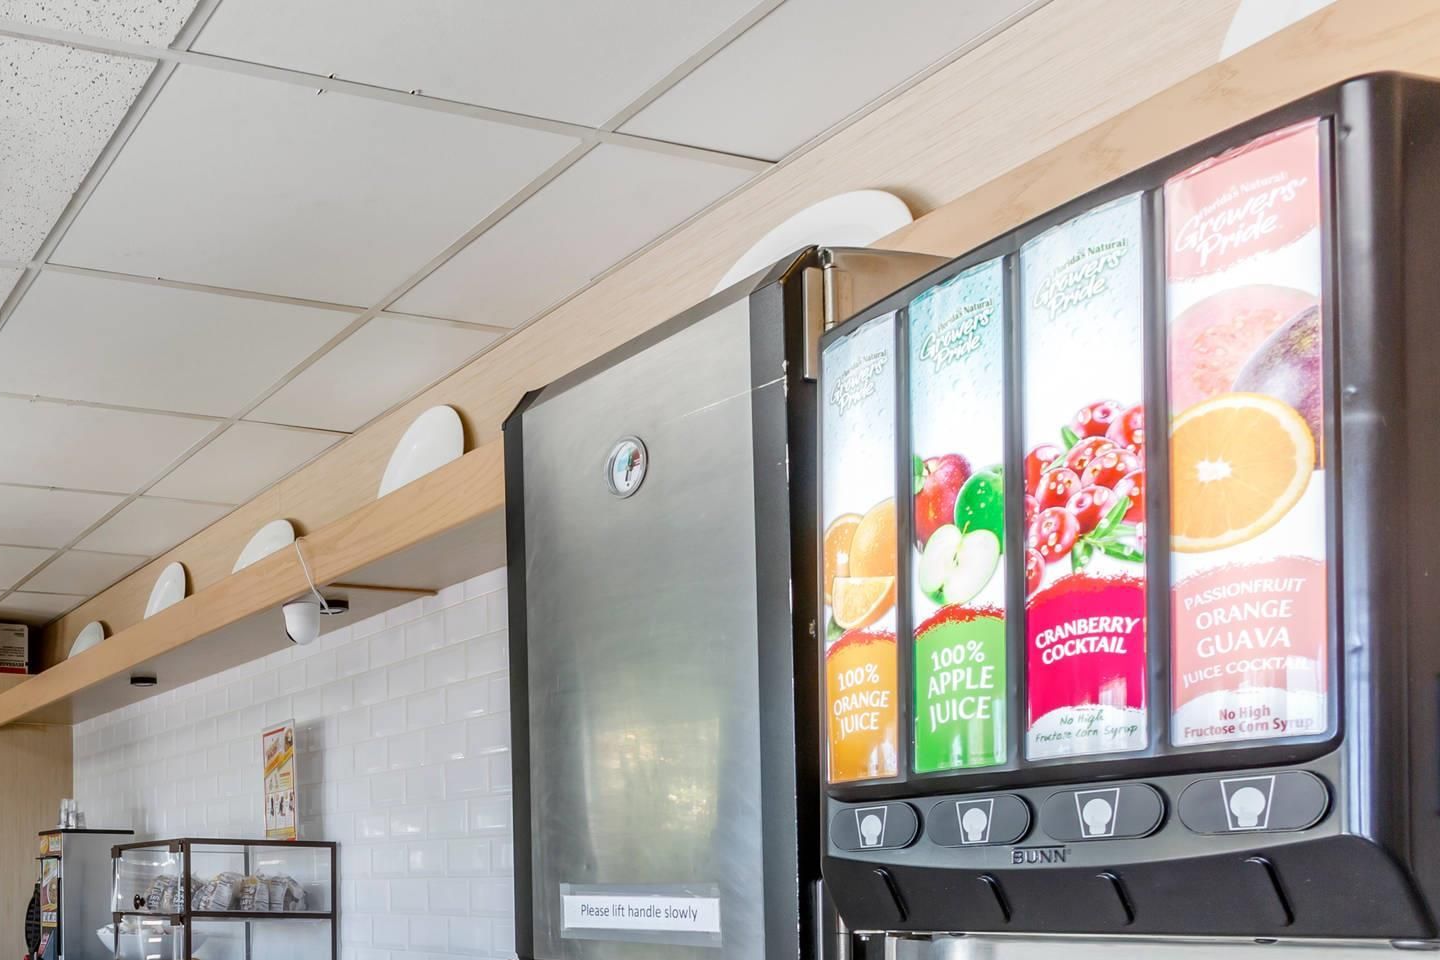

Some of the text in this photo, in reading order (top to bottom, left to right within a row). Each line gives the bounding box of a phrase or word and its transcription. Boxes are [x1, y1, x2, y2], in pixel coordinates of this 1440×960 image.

[1087, 238, 1126, 256] Natural
[1195, 211, 1279, 268] Pride
[963, 299, 993, 314] Natural
[1047, 275, 1108, 321] Pride
[933, 333, 982, 374] Pride
[1183, 578, 1306, 611] PASSIONFRUIT
[1195, 599, 1294, 630] ORANGE
[1035, 615, 1141, 649] CRANBERRY
[1196, 626, 1291, 658] GUAVA
[931, 639, 985, 672] 100%
[1042, 636, 1127, 664] COCKTAIL
[838, 663, 880, 692] 100%
[927, 665, 995, 699] APPLE
[1182, 656, 1312, 688] JUICE COCKTAIL
[833, 689, 891, 716] ORANGE
[930, 695, 991, 733] JUICE
[1219, 705, 1271, 722] No High
[836, 711, 880, 740] JUICE
[1060, 715, 1074, 726] No
[1184, 717, 1314, 738] Fructose Corn Syrup
[1012, 849, 1067, 864] BUNN
[580, 904, 698, 922] Please lift handle slowly
